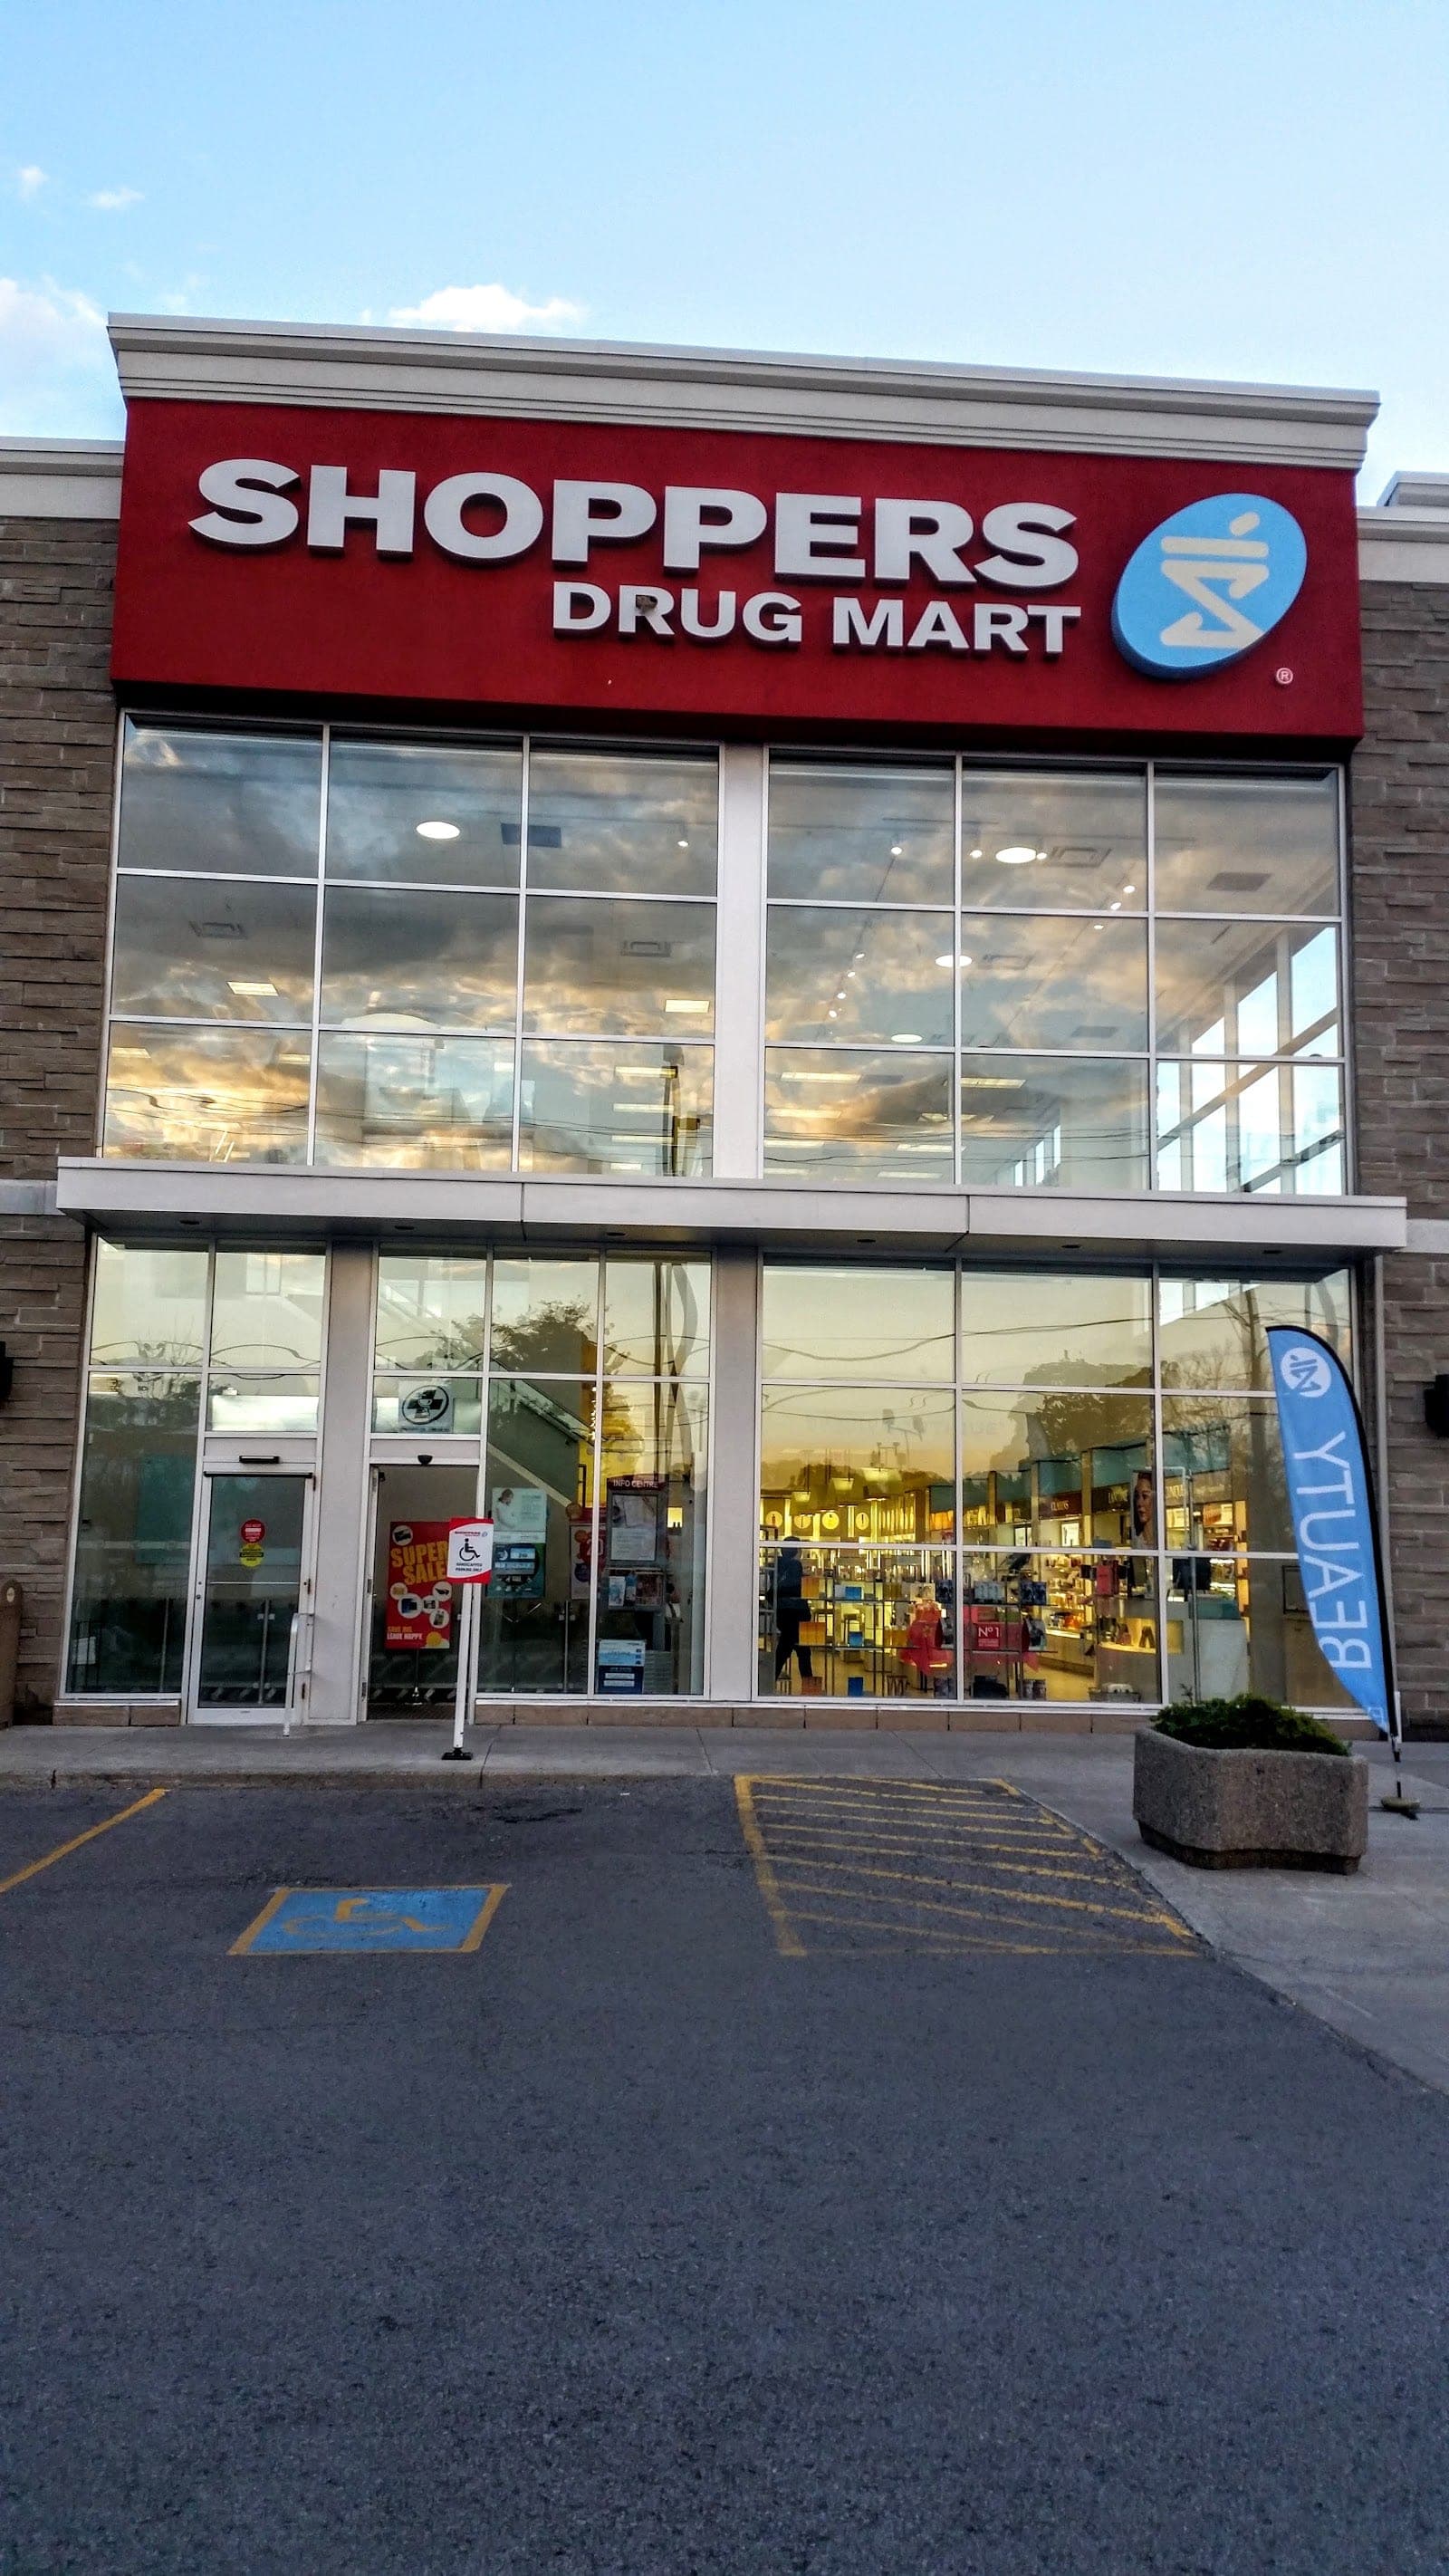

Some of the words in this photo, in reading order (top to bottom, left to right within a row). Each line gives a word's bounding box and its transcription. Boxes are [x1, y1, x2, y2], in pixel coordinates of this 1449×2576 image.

[187, 458, 1080, 591] SHOPPERS
[552, 582, 802, 644] DRUG
[832, 597, 1081, 655] MART
[613, 1479, 630, 1487] INFO
[631, 1480, 658, 1489] CENTRE
[404, 1560, 446, 1585] SALE
